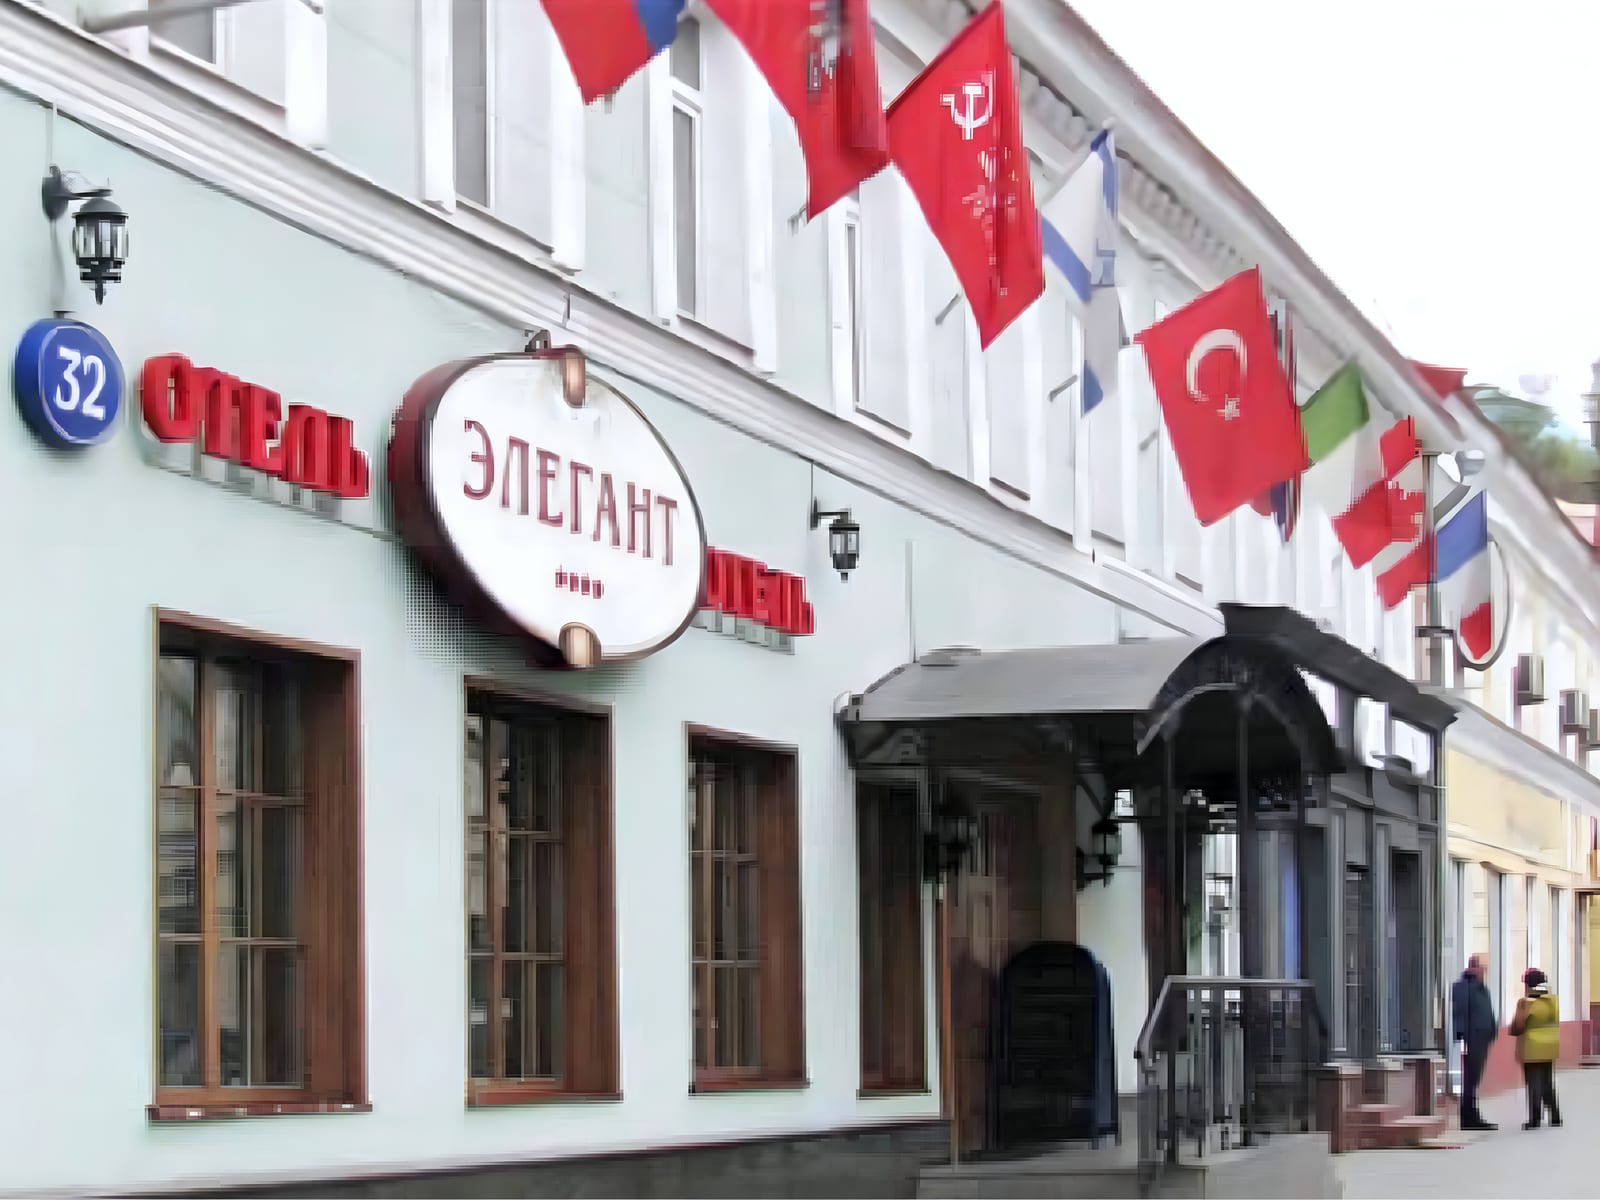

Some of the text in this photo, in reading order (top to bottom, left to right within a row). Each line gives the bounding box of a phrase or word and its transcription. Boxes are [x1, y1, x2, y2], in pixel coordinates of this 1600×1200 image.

[54, 345, 106, 420] 32
[139, 352, 372, 498] ОТЕЛЬ
[463, 417, 678, 566] ЭЛЕГАНТ
